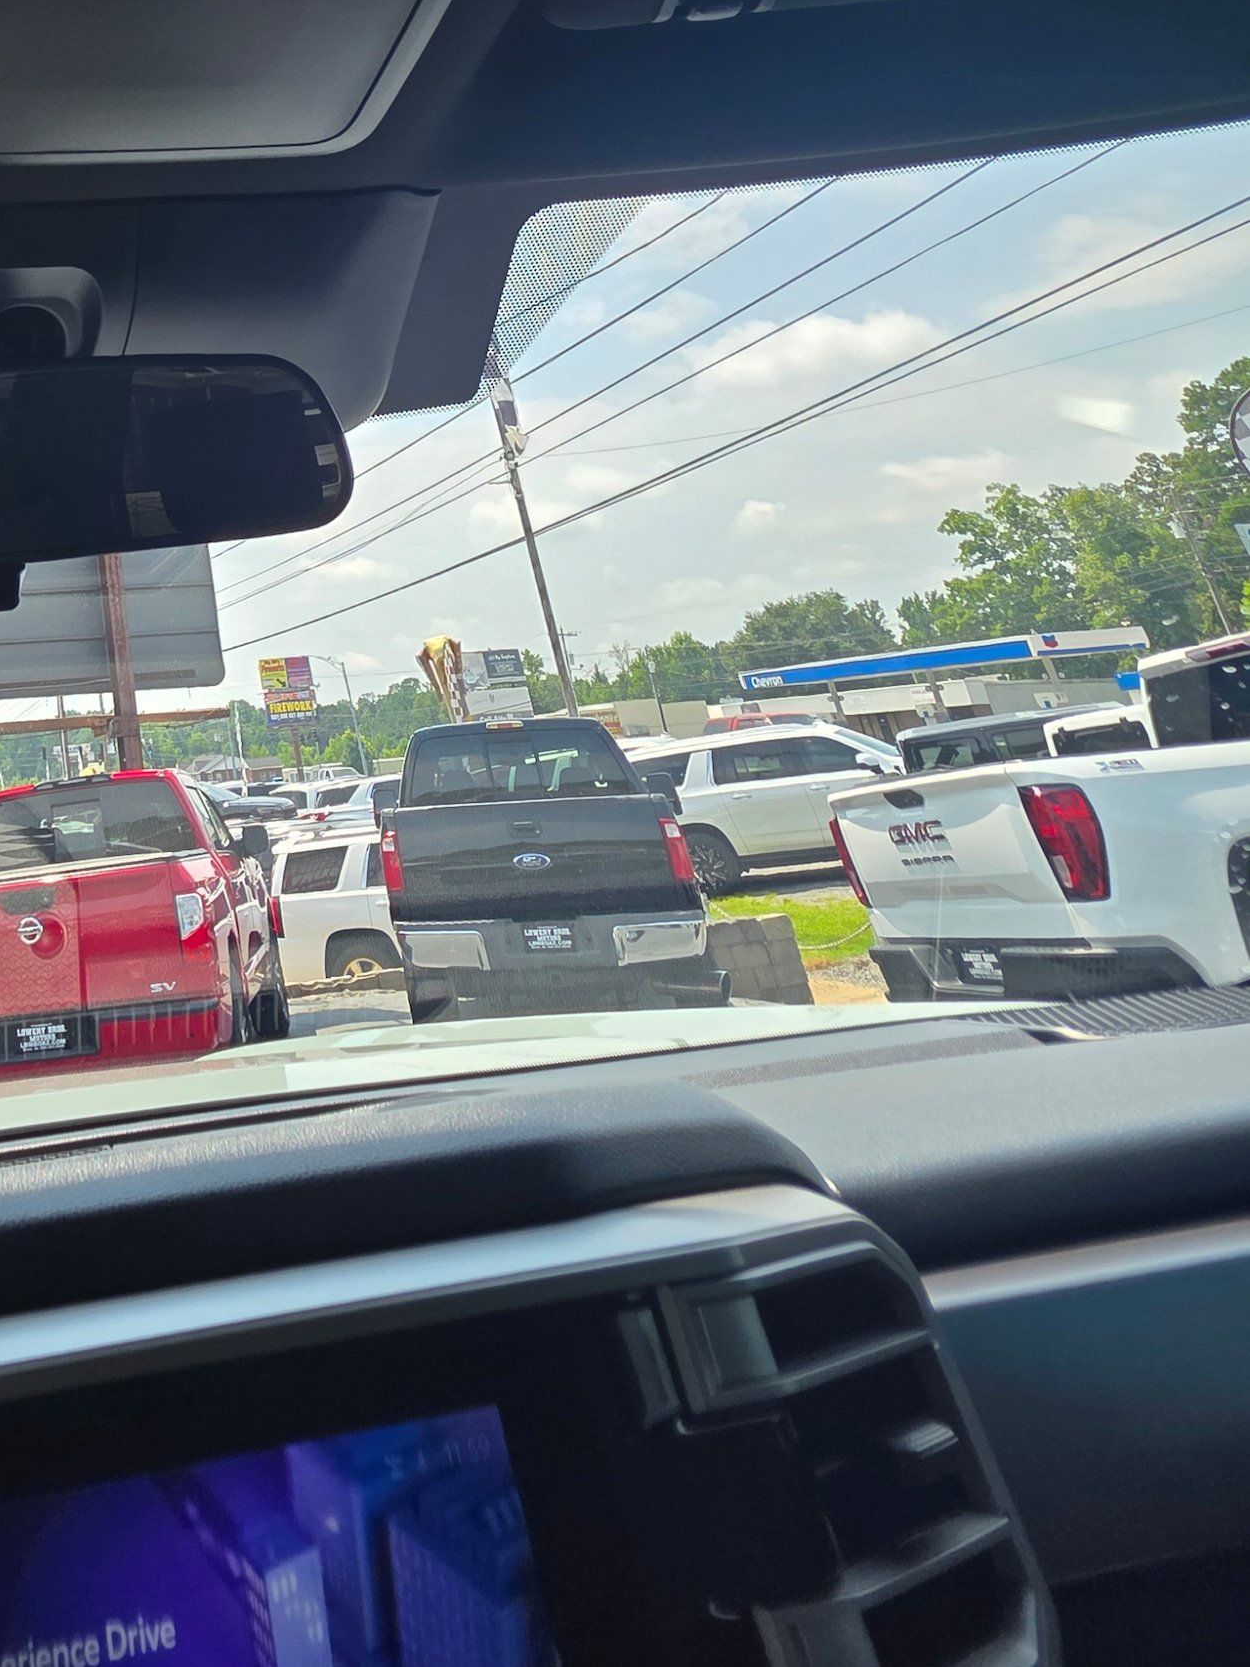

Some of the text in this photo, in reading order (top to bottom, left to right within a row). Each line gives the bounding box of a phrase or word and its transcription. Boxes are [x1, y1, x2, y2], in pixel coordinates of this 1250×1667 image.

[751, 675, 784, 688] Chevron
[888, 819, 946, 846] GMC
[901, 854, 955, 866] SIERRA
[150, 981, 177, 993] SV
[105, 1613, 176, 1662] Drive
